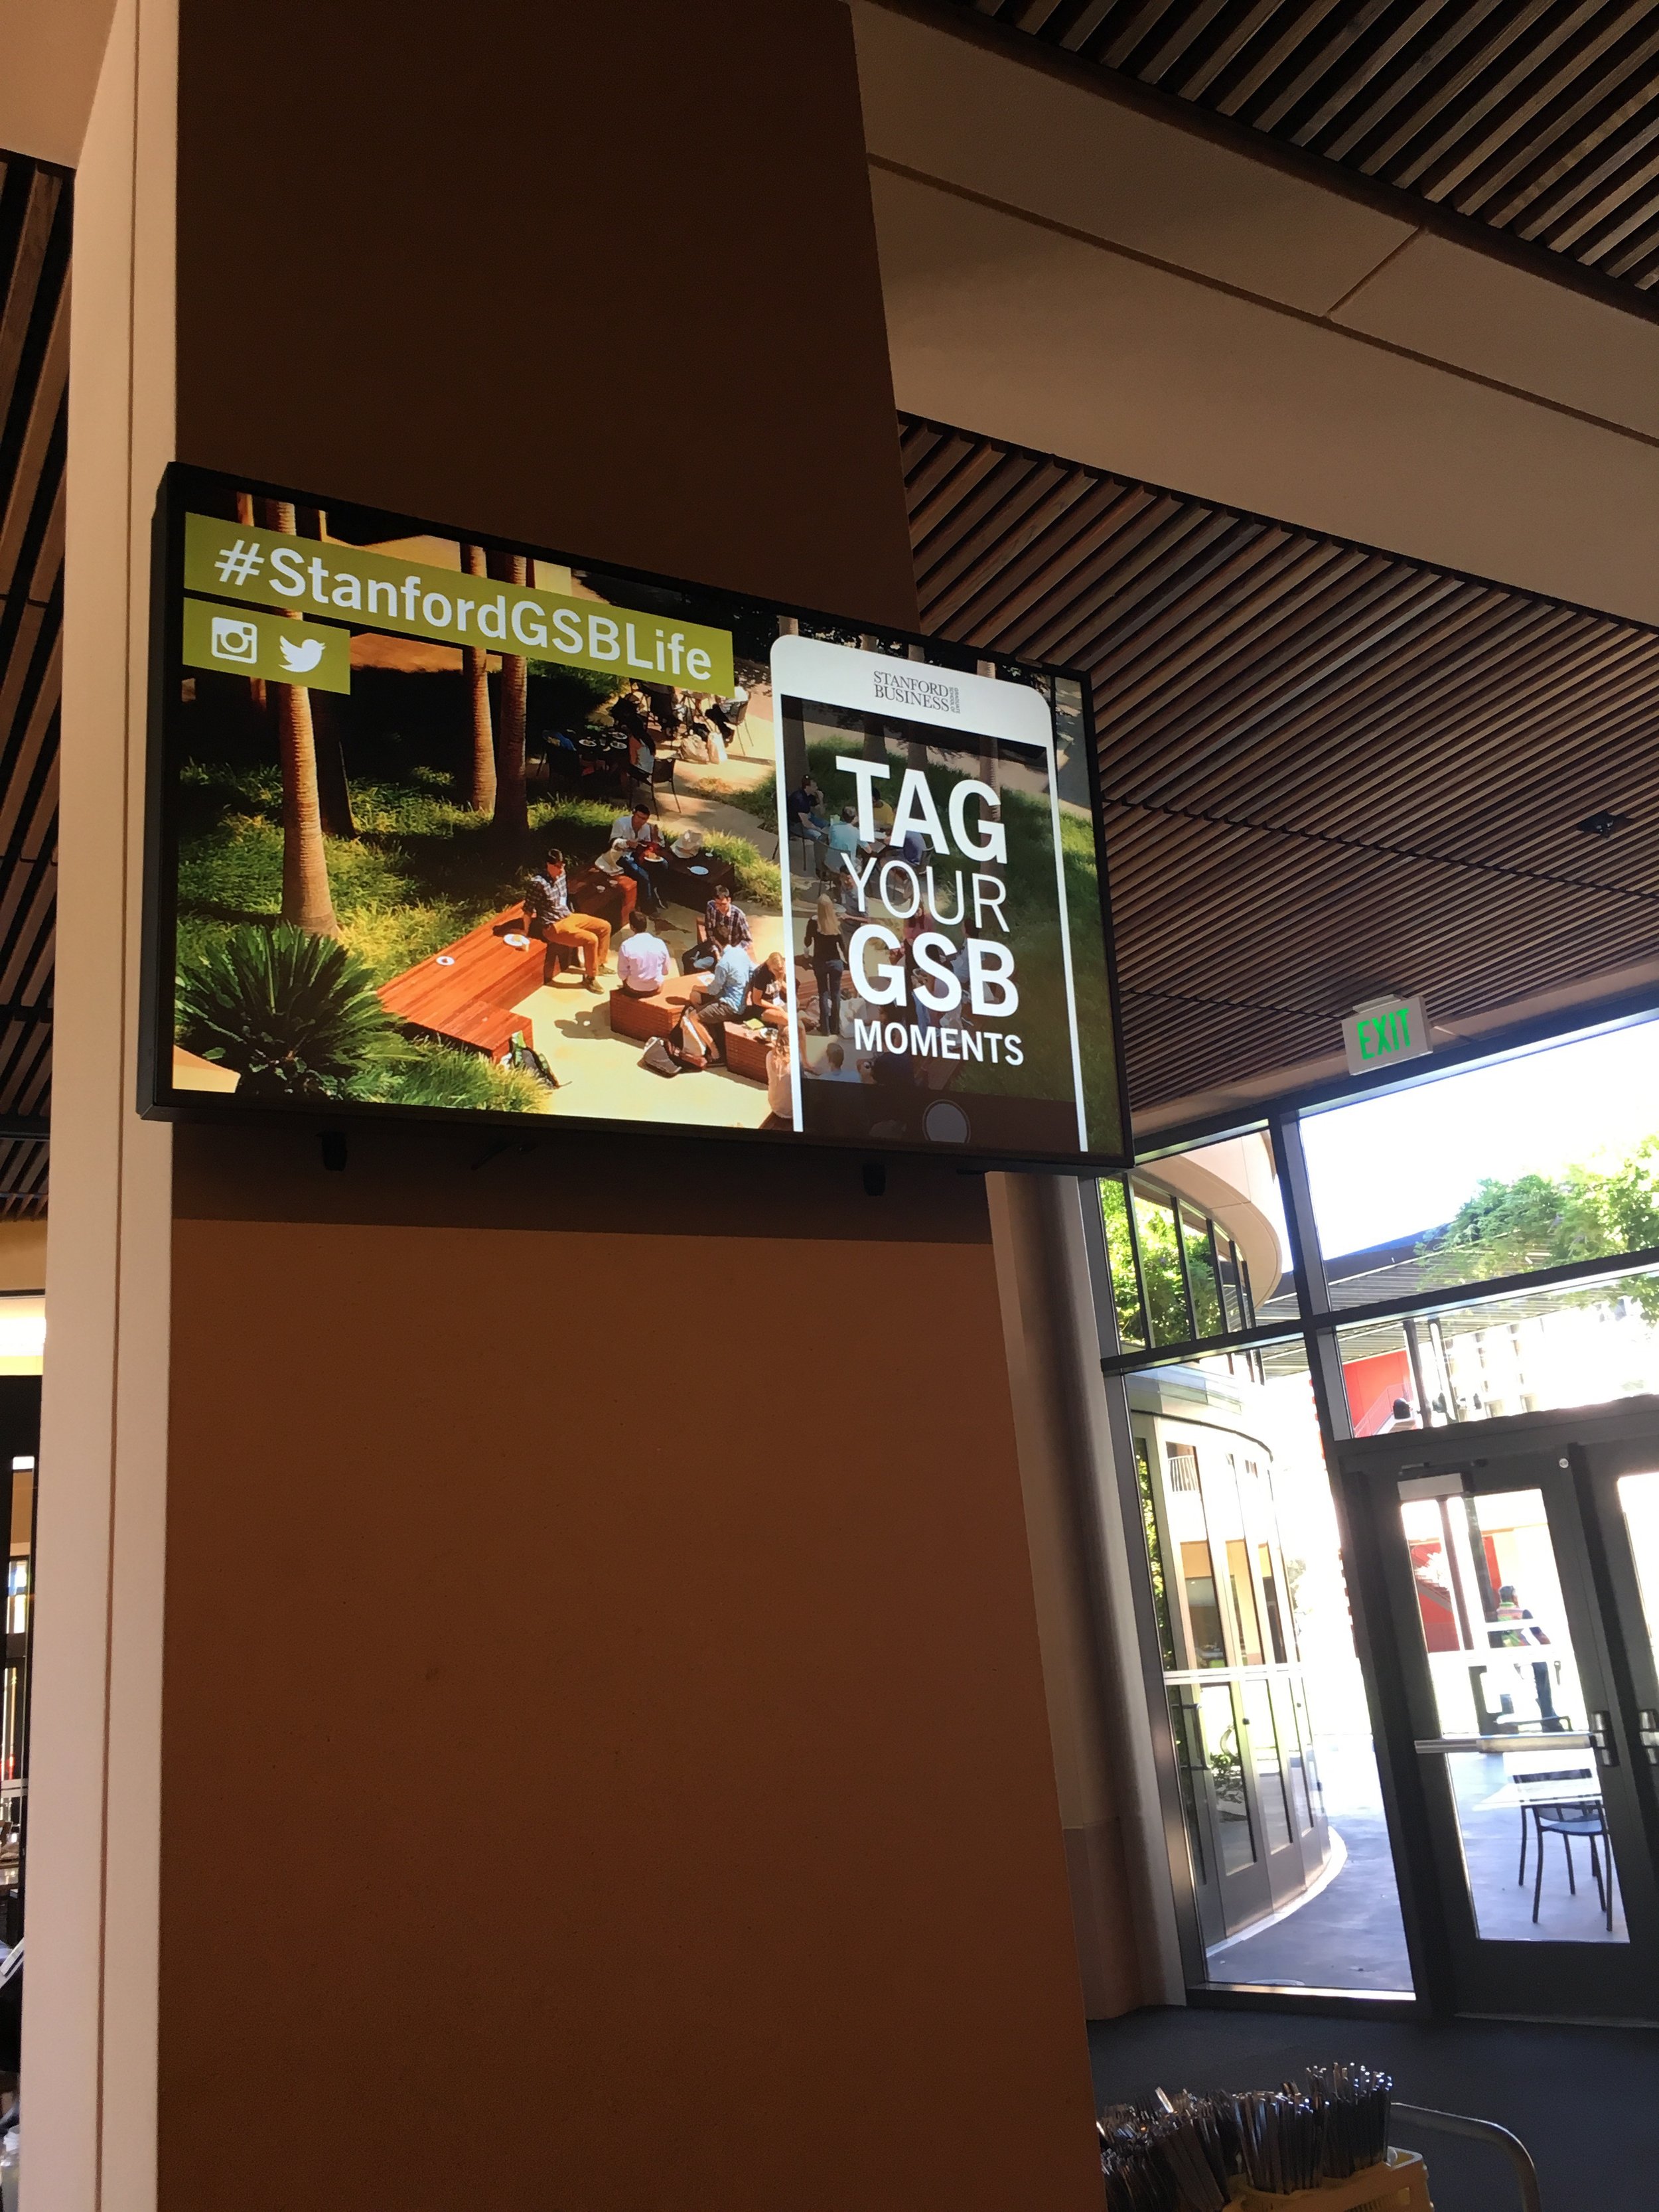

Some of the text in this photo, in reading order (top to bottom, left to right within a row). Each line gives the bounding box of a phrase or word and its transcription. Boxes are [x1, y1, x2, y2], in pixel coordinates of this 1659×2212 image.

[214, 539, 712, 680] #StanfordGSBLife
[873, 671, 948, 697] STANFORD
[875, 684, 949, 711] BUSINESS
[836, 755, 1007, 865] TAG
[839, 852, 1009, 932] YOUR
[849, 924, 1019, 1017] GSB
[854, 1019, 1024, 1066] MOMENTS
[1357, 1008, 1411, 1060] EXIT
